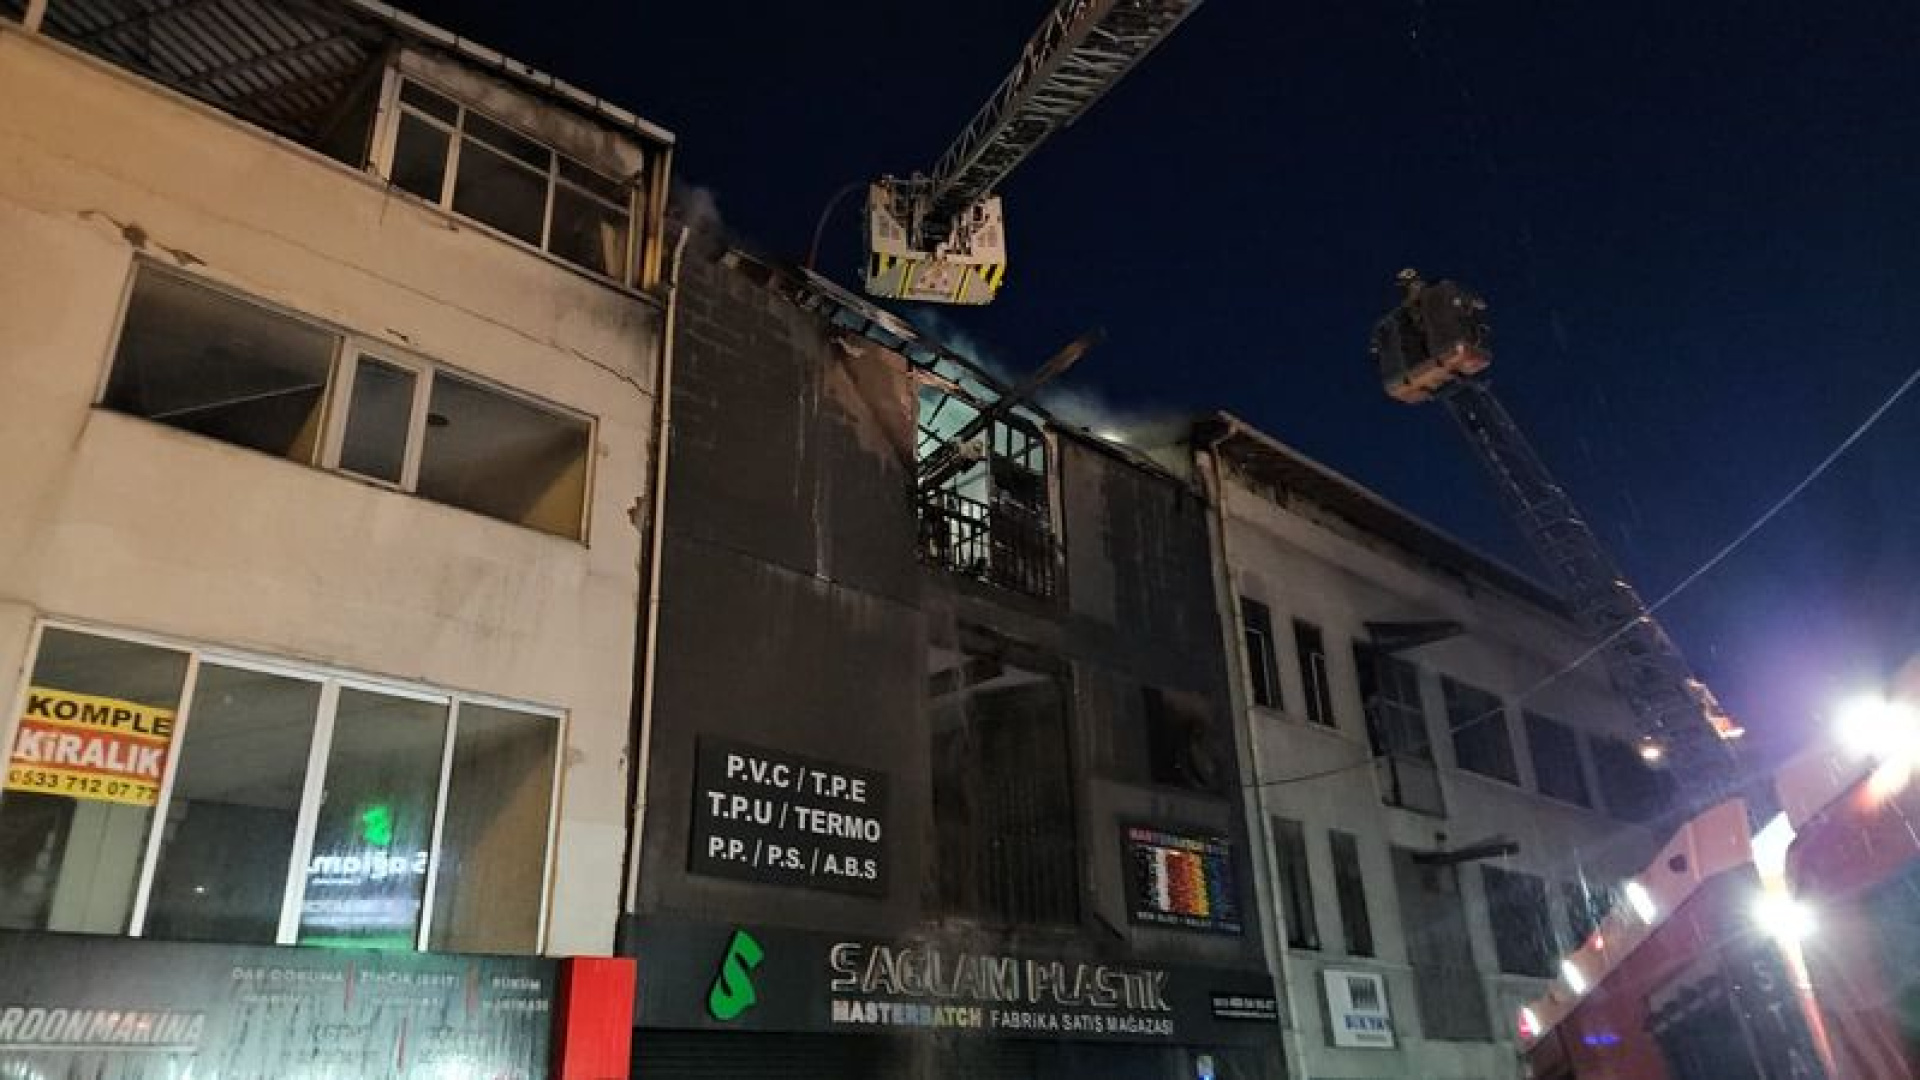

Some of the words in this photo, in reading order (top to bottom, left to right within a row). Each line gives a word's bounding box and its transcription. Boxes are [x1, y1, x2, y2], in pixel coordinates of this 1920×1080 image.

[27, 693, 174, 737] KOMPLE
[9, 769, 58, 788] 0533
[66, 774, 101, 793] 712
[108, 781, 130, 796] 07
[727, 754, 790, 788] P.V.C
[810, 770, 866, 803] T.P.E
[708, 791, 772, 824] T.P.U
[795, 806, 881, 842] TERMO
[708, 835, 748, 863] P.P.
[823, 853, 877, 879] A.B.S
[832, 1000, 982, 1028] MASTERBATCH
